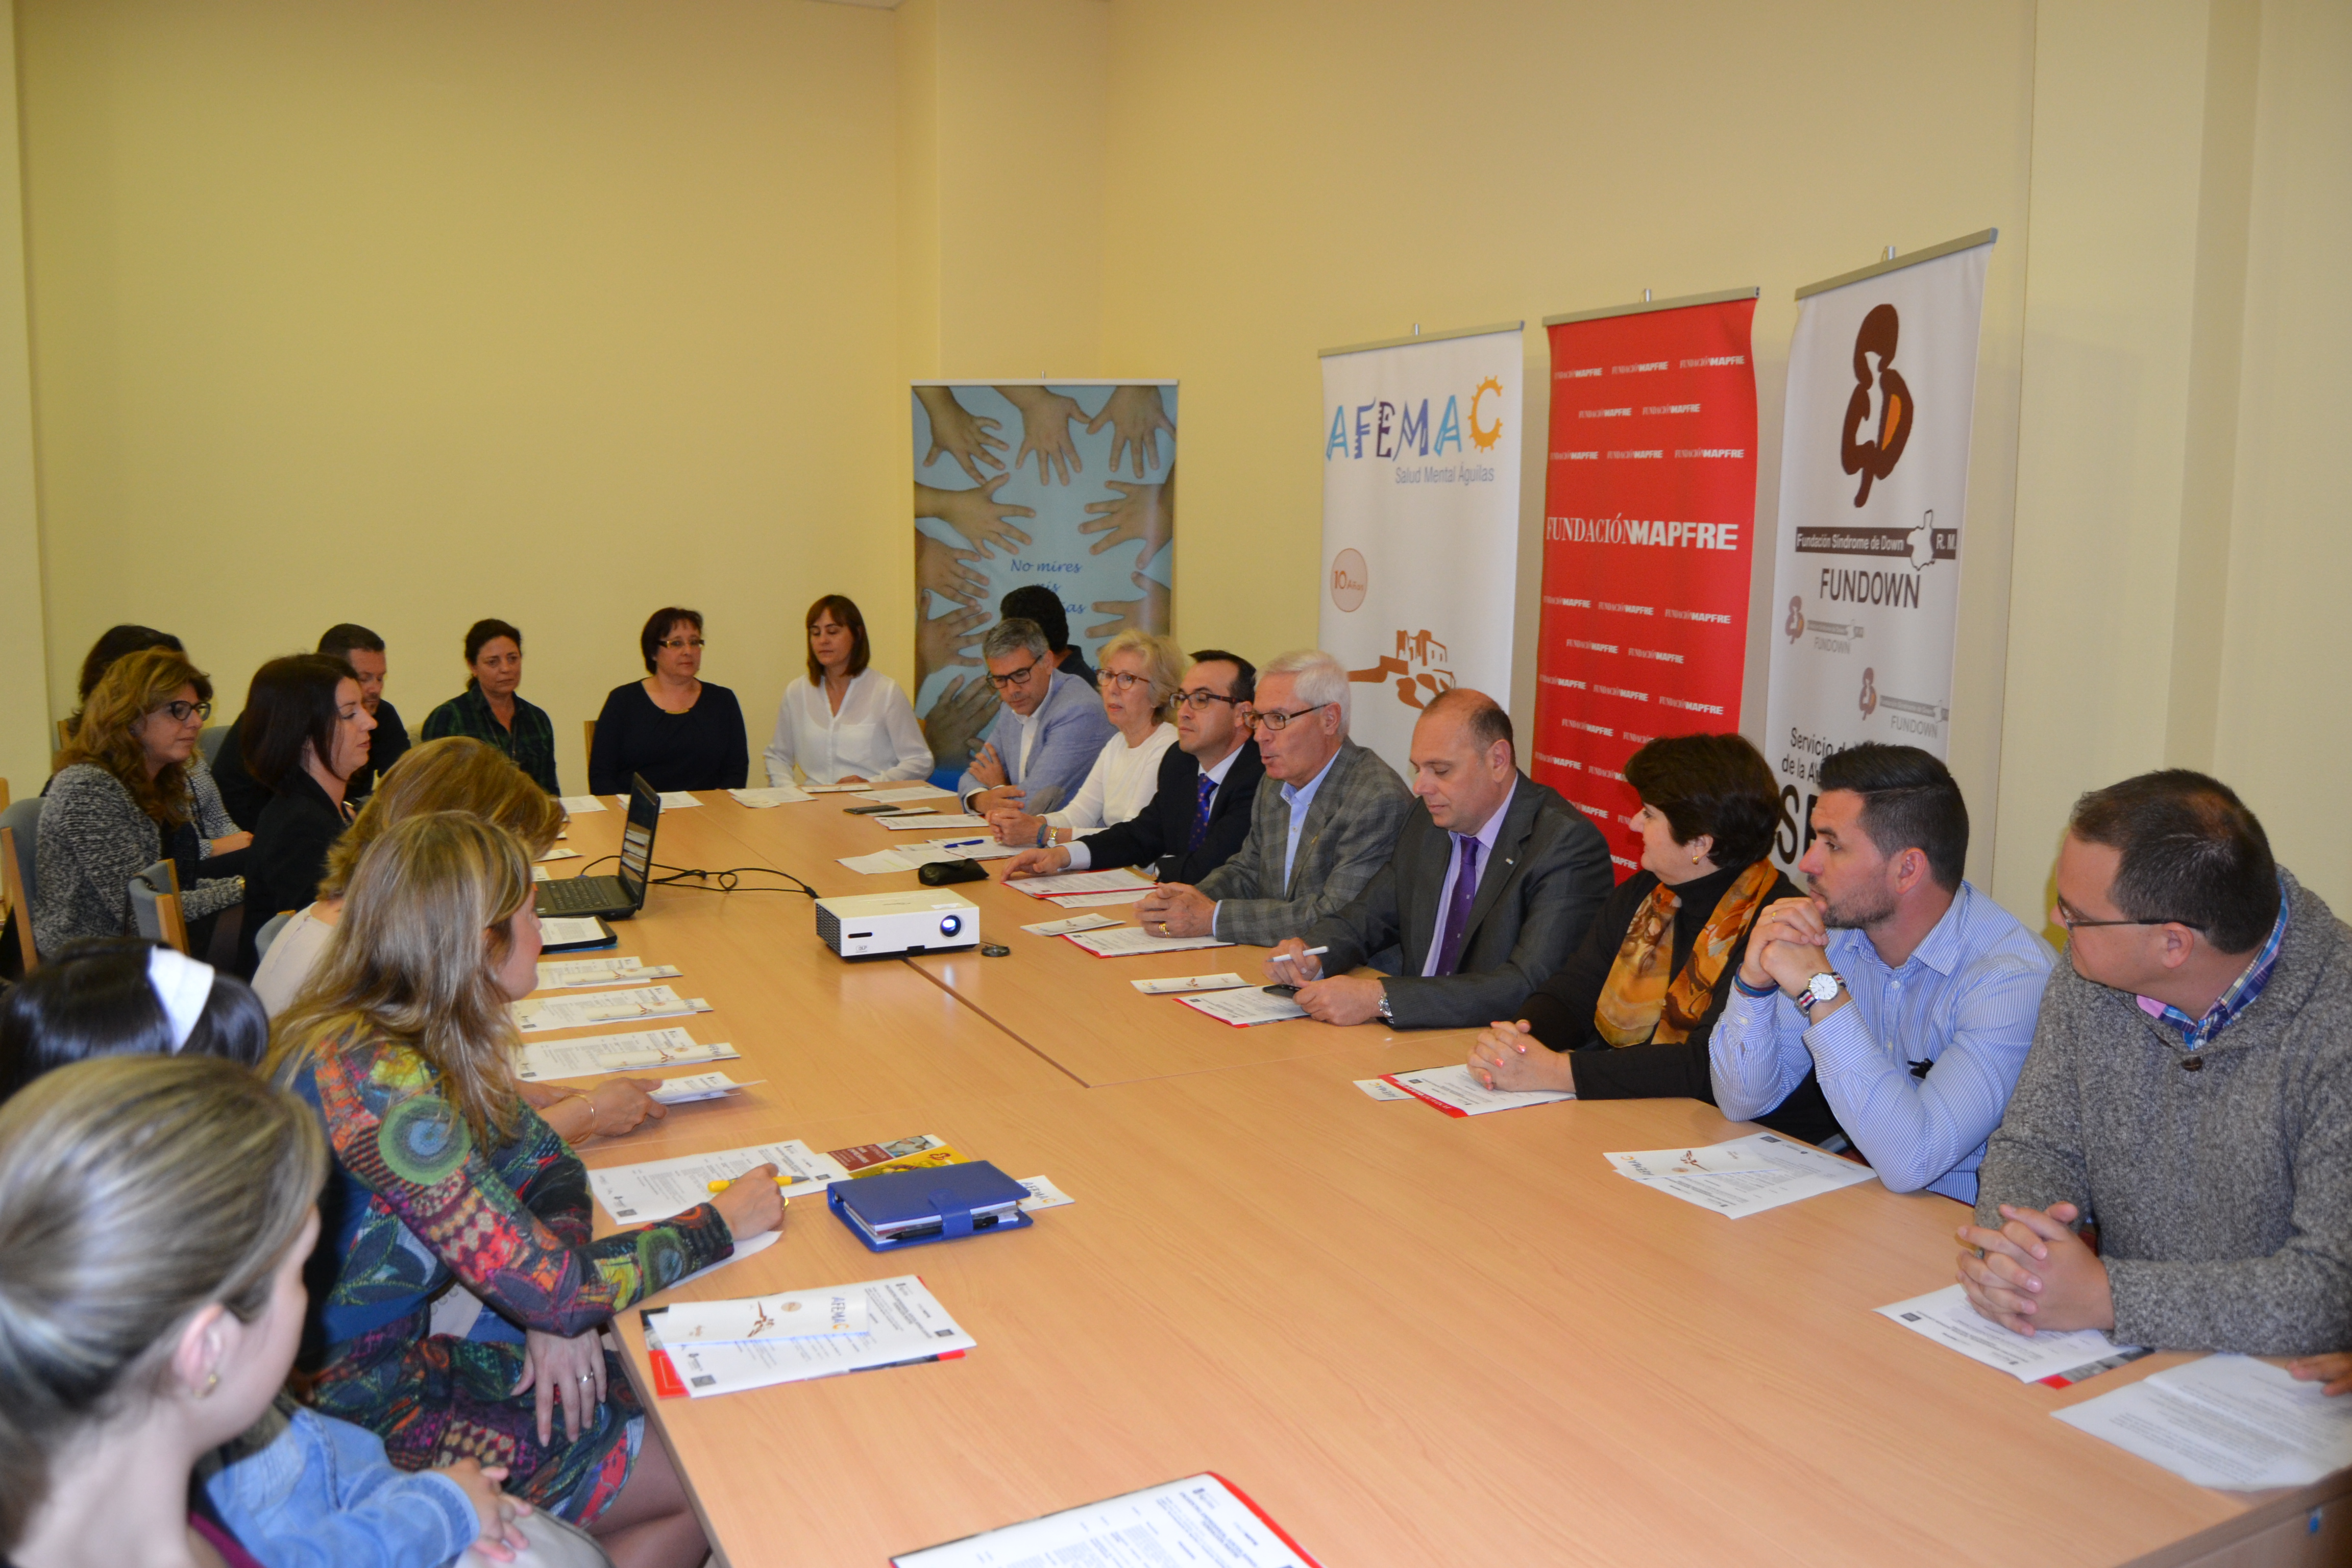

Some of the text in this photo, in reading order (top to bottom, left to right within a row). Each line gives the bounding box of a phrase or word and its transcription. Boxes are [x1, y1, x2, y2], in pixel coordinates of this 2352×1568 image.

[1326, 375, 1503, 461] AFEMAC
[1396, 461, 1494, 485] Salud Mental Águilas
[1797, 533, 1831, 548] Fundación
[1832, 533, 1869, 550] Síndrome
[1870, 535, 1880, 550] de
[1881, 535, 1904, 551] Down
[1011, 559, 1083, 573] No mires
[1335, 570, 1346, 589] 10
[1820, 568, 1920, 609] FUNDOWN
[1890, 715, 1938, 739] FUNDOWN
[1791, 727, 1833, 757] Servicio
[1782, 753, 1795, 775] de
[1797, 757, 1805, 779] la
